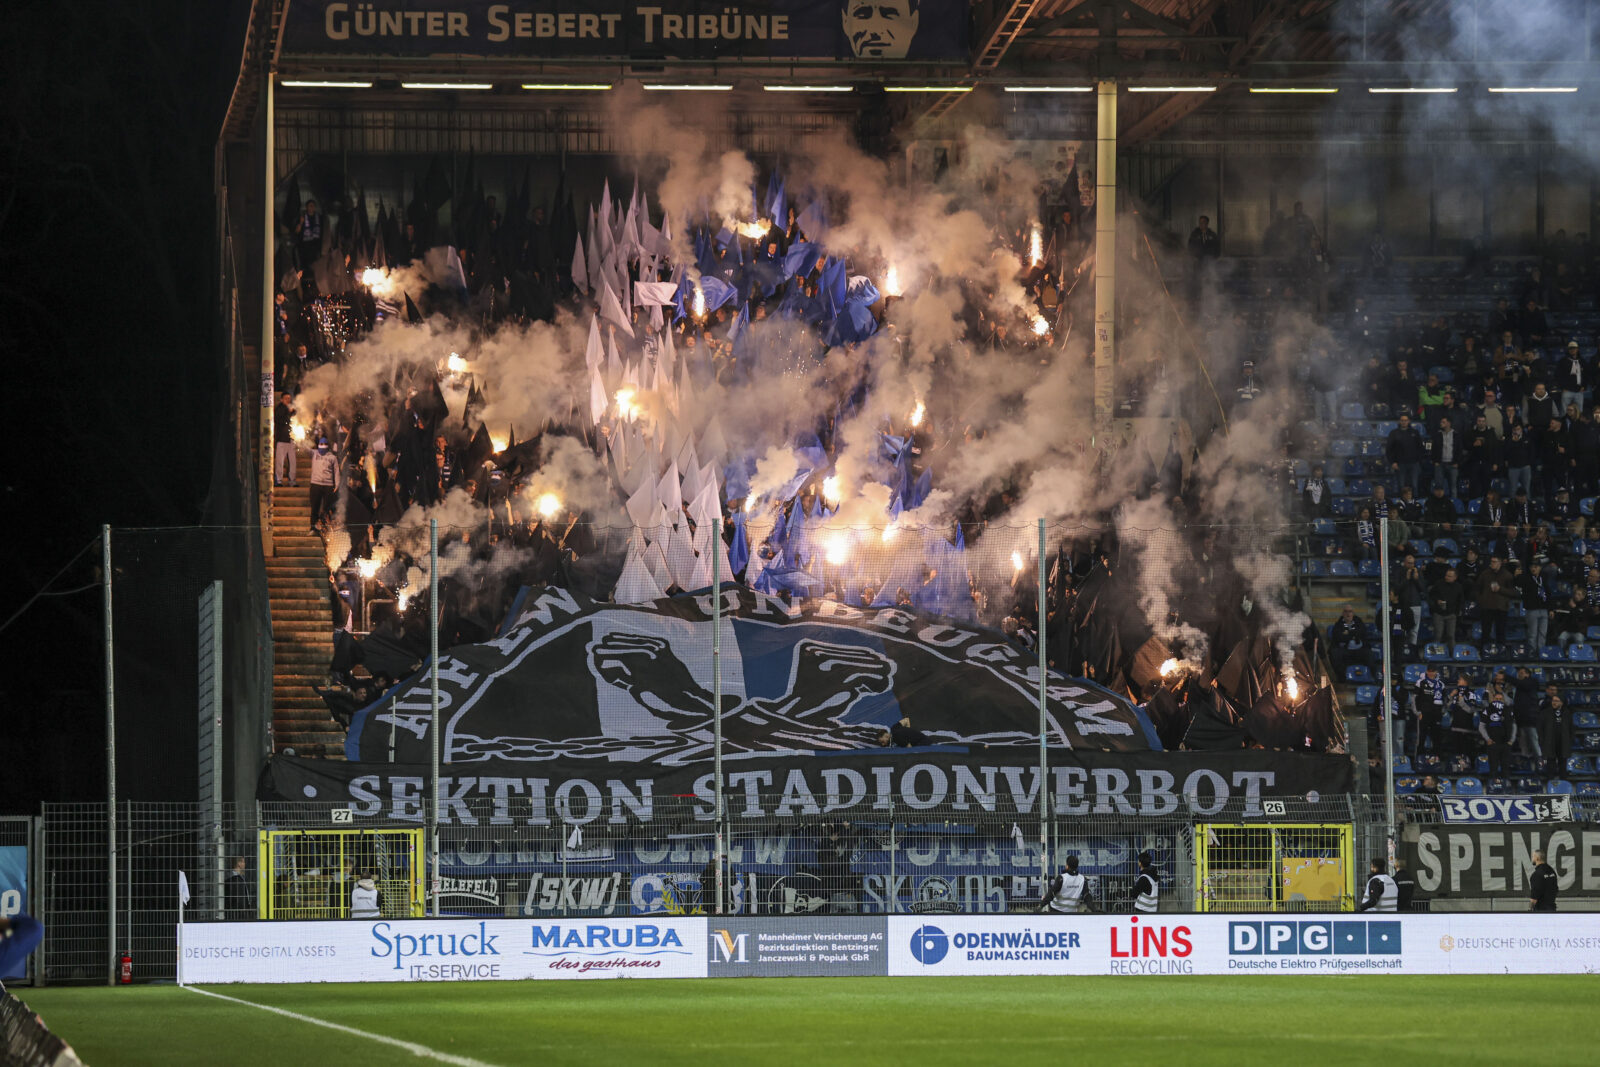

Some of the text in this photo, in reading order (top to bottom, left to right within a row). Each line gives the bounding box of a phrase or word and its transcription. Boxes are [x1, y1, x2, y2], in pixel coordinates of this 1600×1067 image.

[487, 4, 622, 42] SEBERT
[636, 7, 789, 43] TRIBÜNE
[348, 763, 1275, 826] SEKTION STADIONVERBOT
[1265, 802, 1283, 813] 26
[1442, 798, 1535, 823] BOYS
[334, 809, 350, 821] 27
[758, 932, 883, 943] Mannheimer Versicherung AG
[953, 928, 1081, 949] ODENWÄLDER
[1457, 937, 1515, 949] DEUTSCHE
[1519, 937, 1561, 949] DIGITAL
[185, 945, 337, 959] DEUTSCHE DIGITAL ASSETS
[371, 921, 500, 970] Spruck
[758, 943, 879, 953] Bezirksdirektion Bentzinger,
[758, 954, 870, 964] Janczewski & Popiuk GbR
[967, 950, 1070, 961] BAUMASCHINEN
[410, 964, 500, 978] IT-SERVICE
[1110, 960, 1193, 975] RECYCLING
[1228, 958, 1402, 971] Deutsche Elektro Prüfgesellschaft
